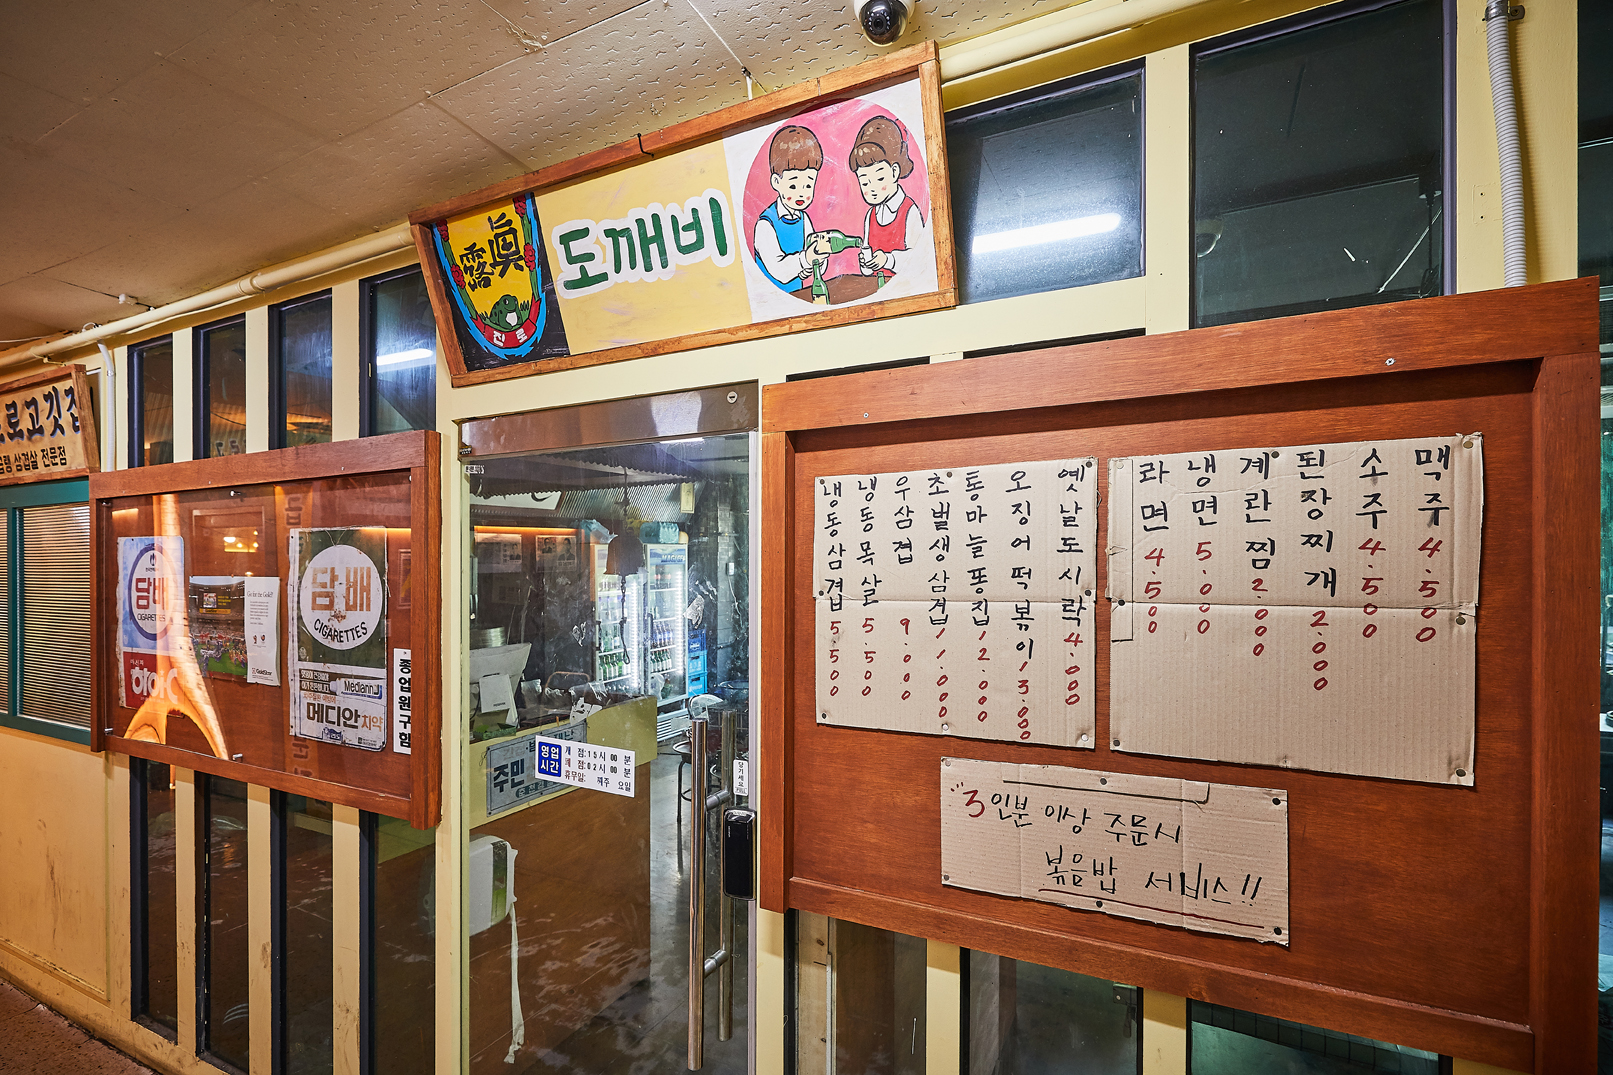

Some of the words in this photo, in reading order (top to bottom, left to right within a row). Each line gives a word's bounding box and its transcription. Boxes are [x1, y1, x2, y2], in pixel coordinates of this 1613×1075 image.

[559, 196, 728, 290] 도깨비
[14, 450, 39, 472] 삼겹살
[41, 445, 67, 468] 전문점
[1355, 448, 1388, 529] 소주
[1414, 445, 1450, 527] 맥주
[892, 475, 914, 564] 우삼겹
[1139, 460, 1170, 532] 라면
[1187, 454, 1218, 526] 냉면
[1239, 451, 1276, 569] 계란찜
[824, 481, 846, 612] 냉동삼겹
[857, 476, 882, 606] 냉동목살
[928, 472, 950, 625] 초벌생삼겹
[1057, 465, 1086, 627] 옛날도시락
[1297, 449, 1337, 598] 된장찌개
[135, 577, 169, 610] 담배
[311, 566, 372, 612] 담배
[1005, 470, 1035, 660] 오징어떡볶이
[313, 618, 368, 643] CIGARETTES
[306, 702, 361, 729] 메디안
[361, 714, 384, 732] 치약
[540, 744, 559, 759] 영업
[540, 759, 559, 774] 시간
[564, 745, 571, 756] 개
[624, 755, 632, 767] 분
[624, 768, 632, 779] 분
[737, 761, 745, 788] 당기세요
[617, 780, 631, 792] 요일
[1044, 804, 1092, 834] 이상
[1102, 811, 1181, 846] 주문시
[1044, 844, 1118, 894] 볶음밥
